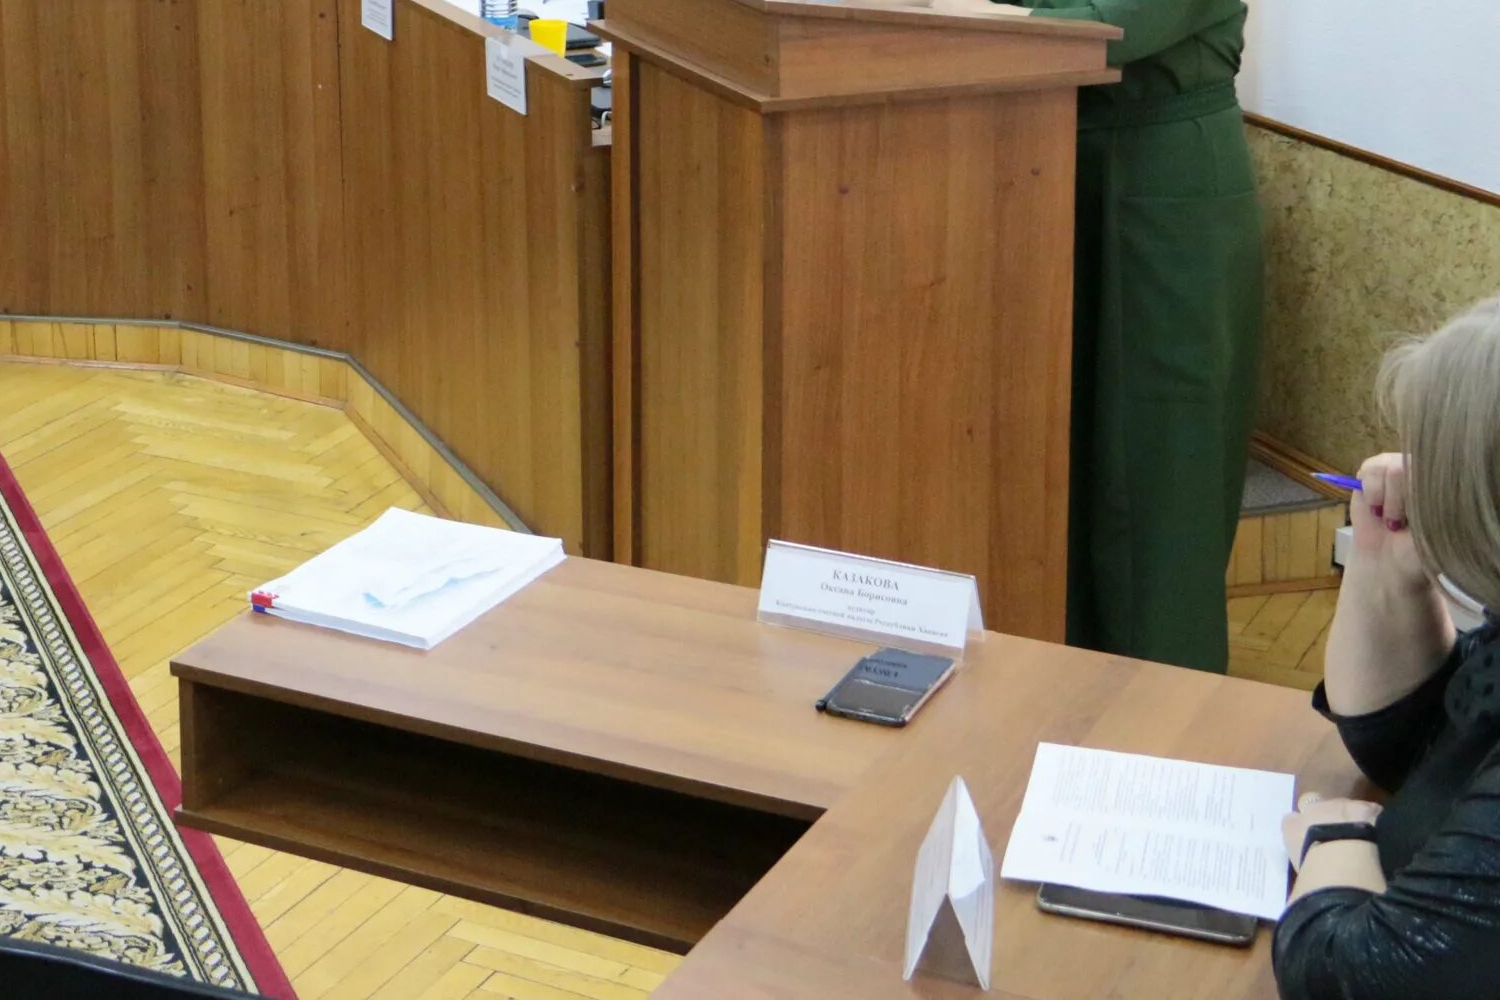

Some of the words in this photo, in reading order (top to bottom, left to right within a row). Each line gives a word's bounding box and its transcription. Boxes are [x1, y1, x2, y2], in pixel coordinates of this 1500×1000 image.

[832, 570, 900, 591] КАЗАКОВА
[820, 582, 855, 597] Оксана
[857, 589, 908, 605] Борисовна
